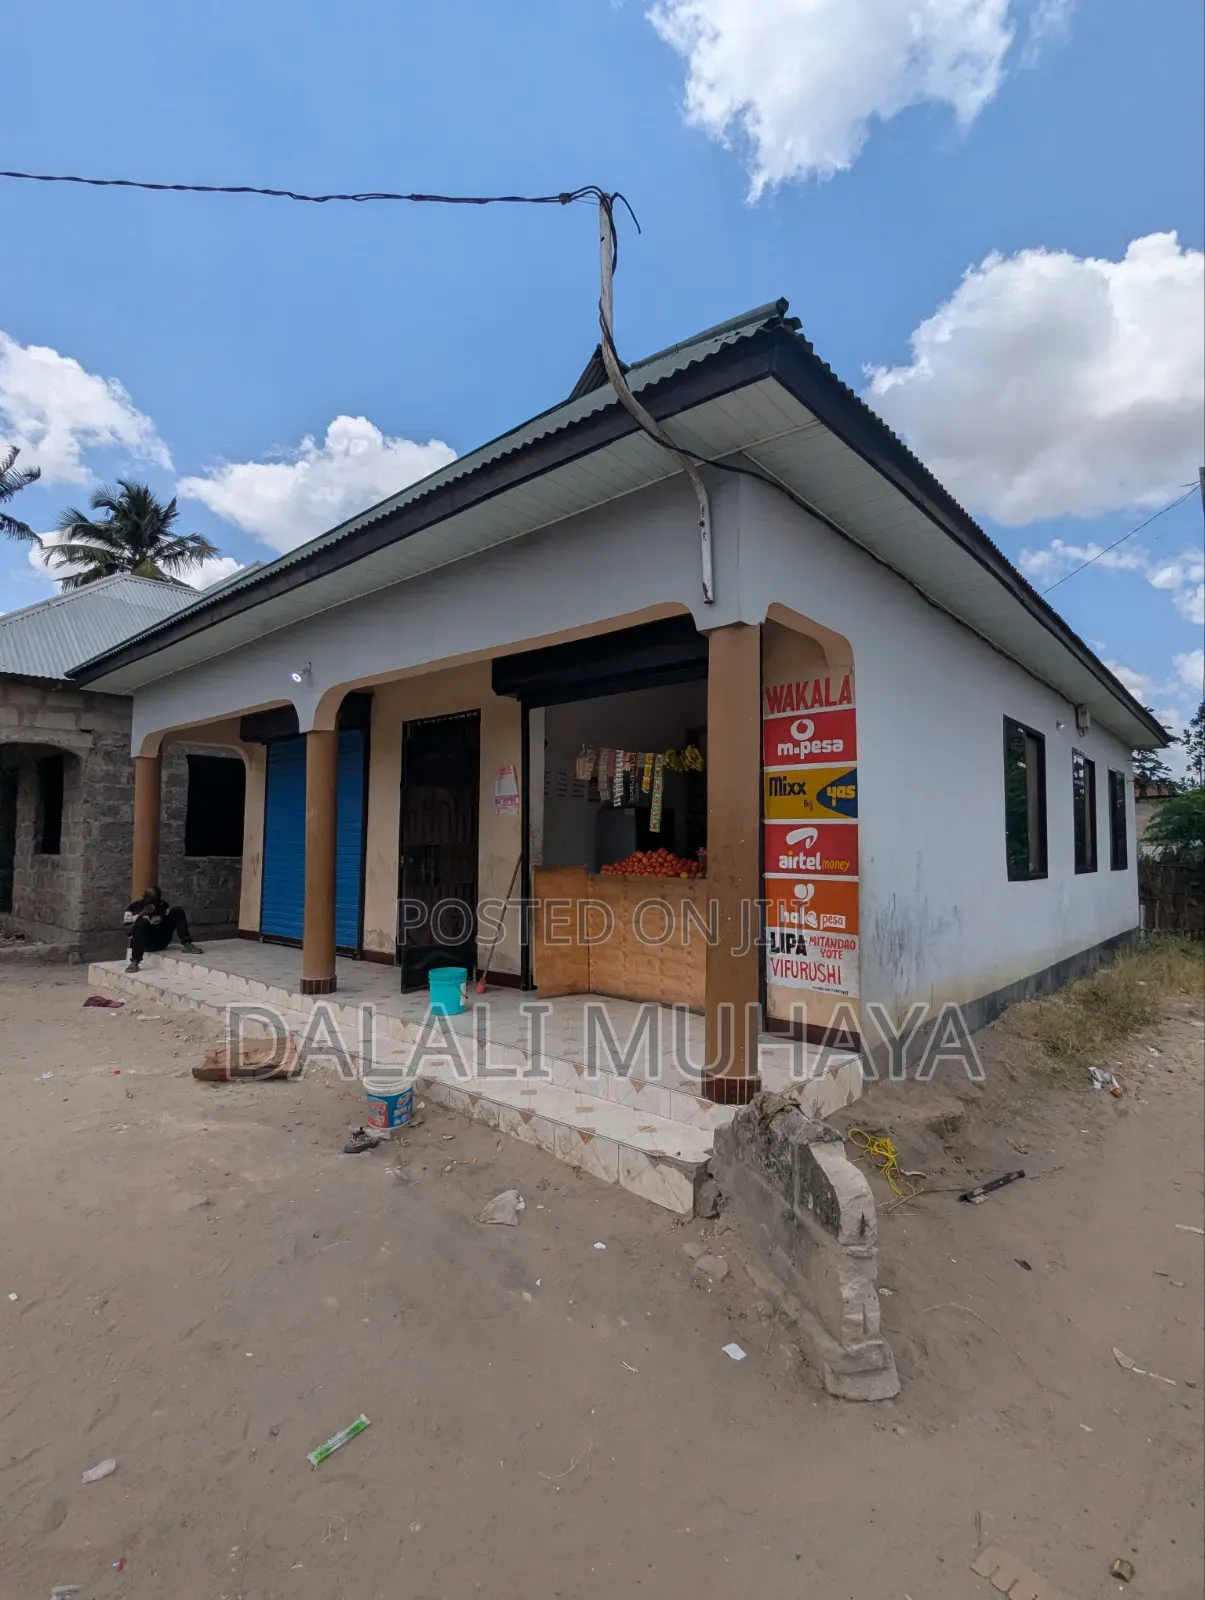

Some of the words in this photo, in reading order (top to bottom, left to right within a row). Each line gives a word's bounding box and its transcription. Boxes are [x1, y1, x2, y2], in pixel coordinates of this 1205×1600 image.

[765, 675, 852, 714] WAKALA
[778, 850, 821, 870] airtel
[822, 859, 851, 872] money
[822, 914, 844, 927] pesa
[770, 931, 808, 957] LIPA
[808, 935, 856, 951] MITANDAO
[820, 949, 843, 960] YOTE
[770, 957, 842, 986] VIFURUSHI
